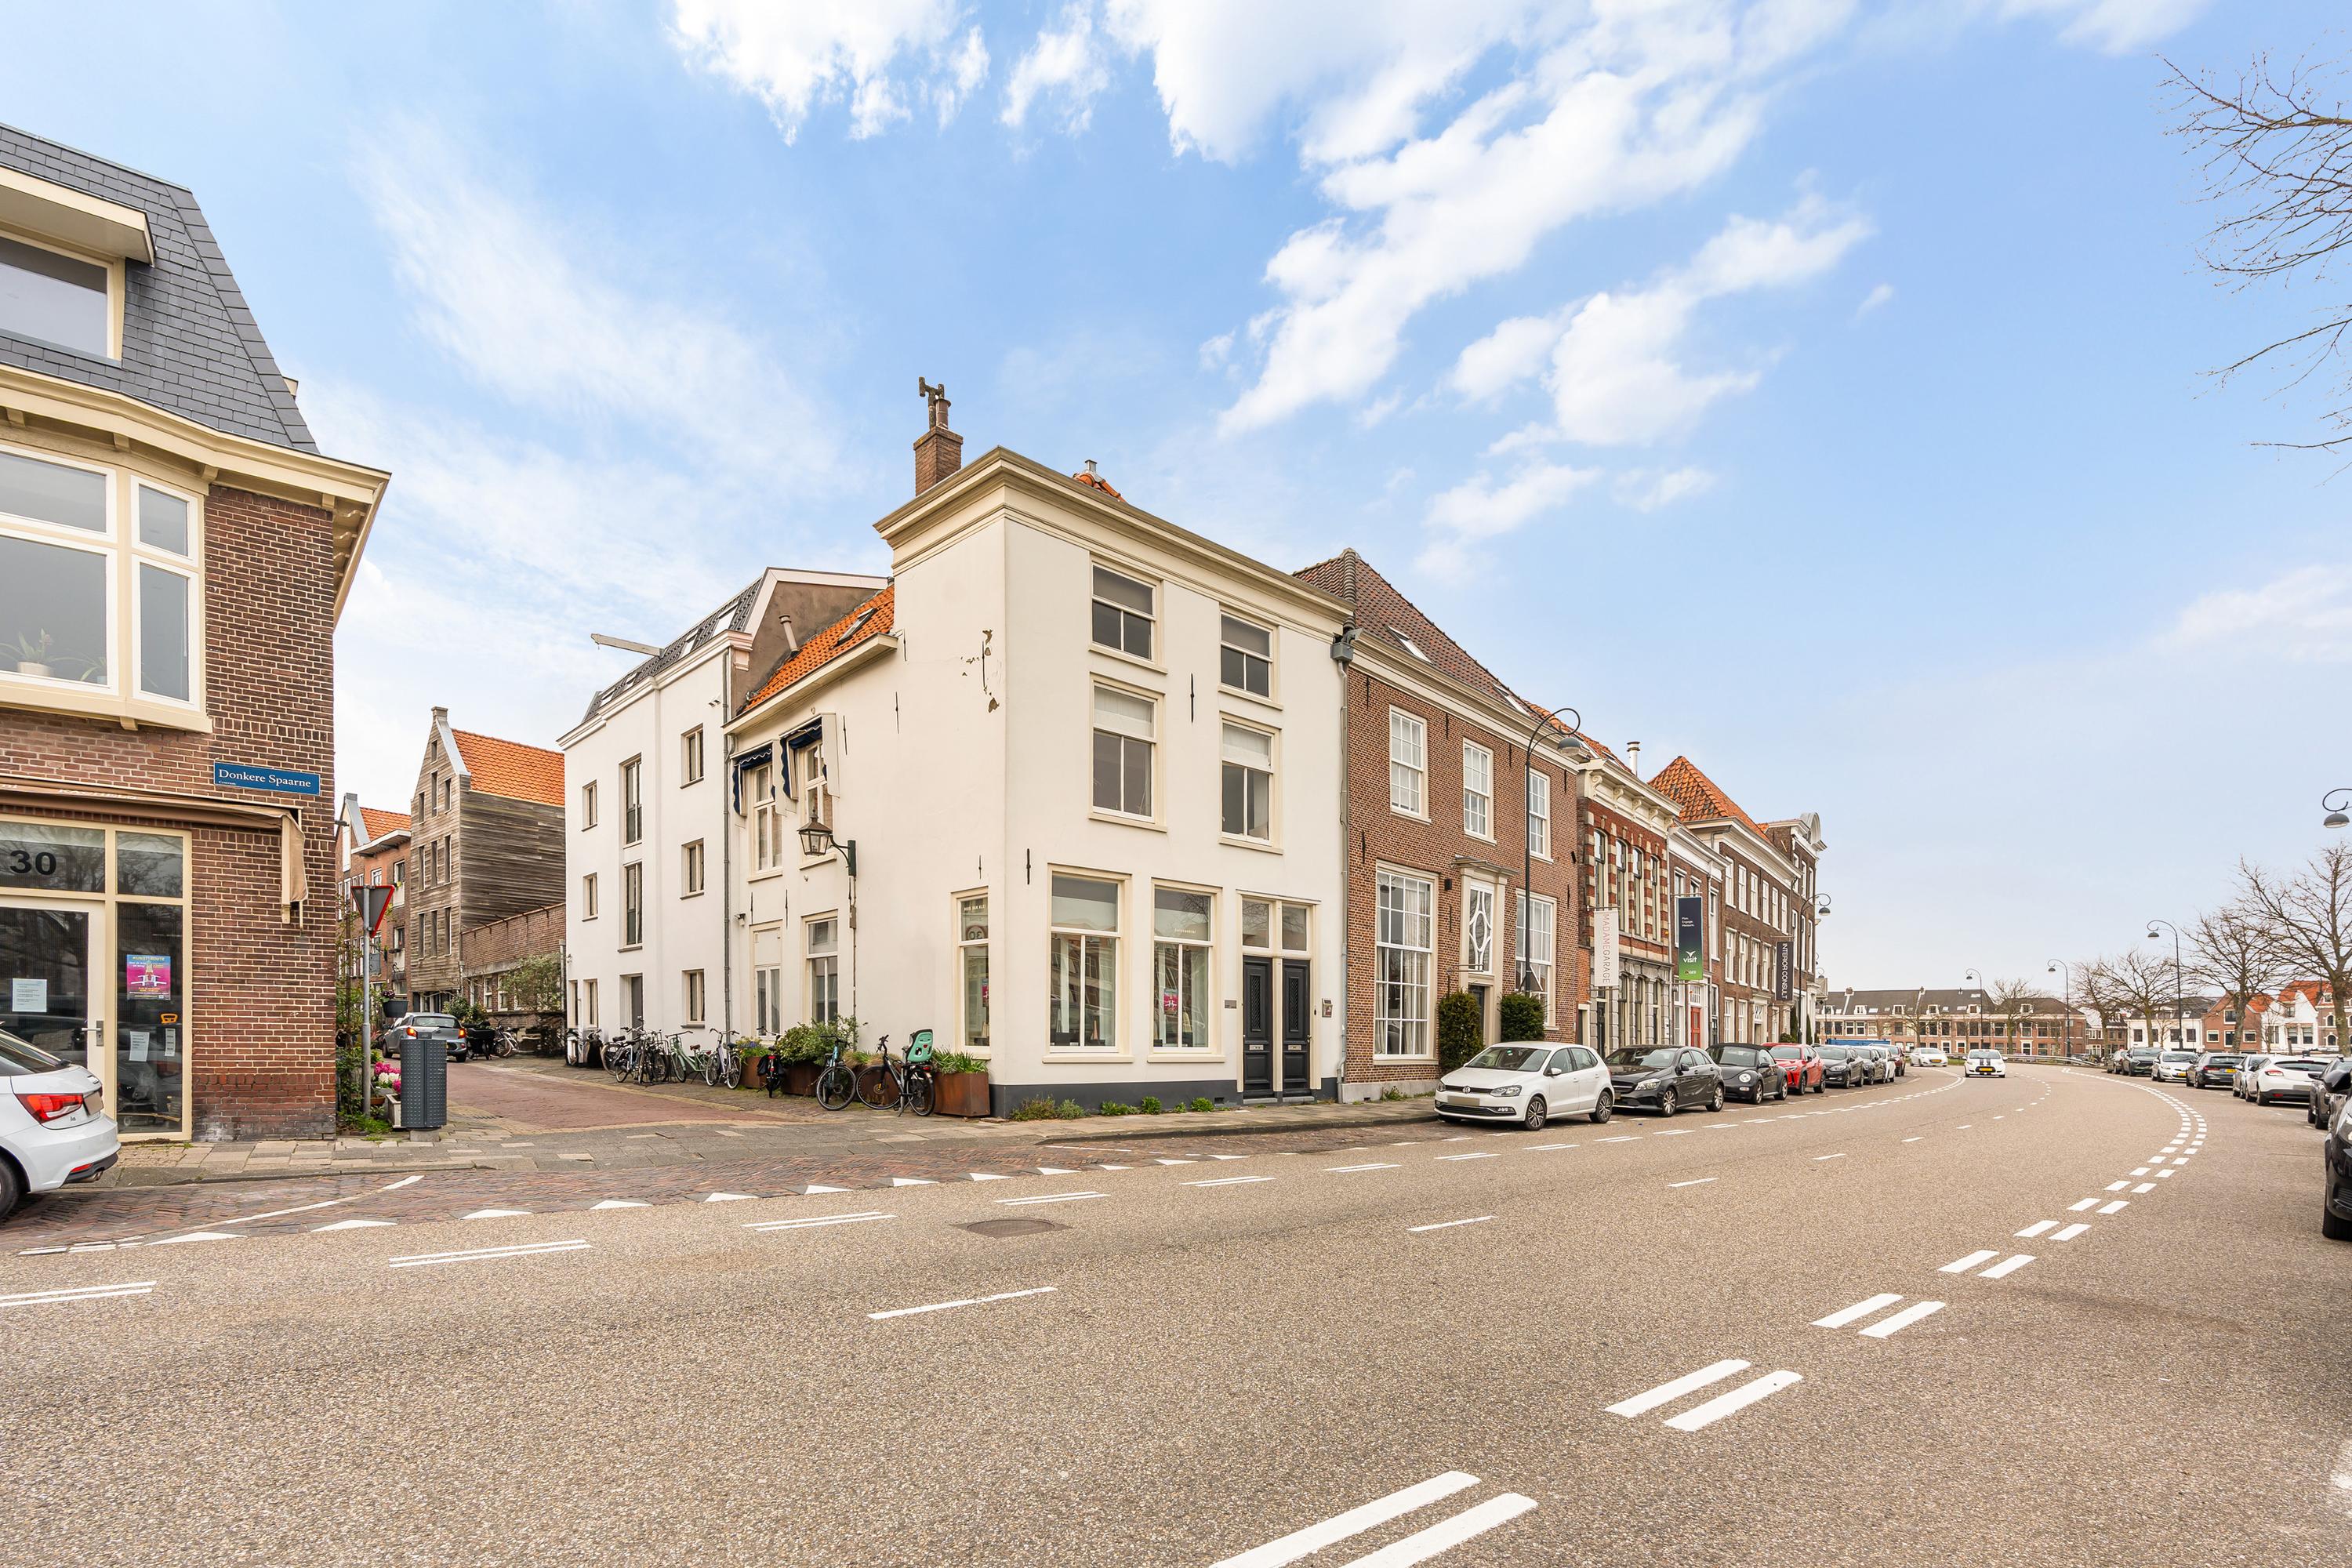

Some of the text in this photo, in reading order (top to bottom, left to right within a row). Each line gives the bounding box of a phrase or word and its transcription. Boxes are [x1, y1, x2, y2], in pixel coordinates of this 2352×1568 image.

[219, 769, 311, 787] Donkere Spaarne
[9, 850, 57, 876] 30
[1602, 913, 1610, 983] MADAMEGARAGE
